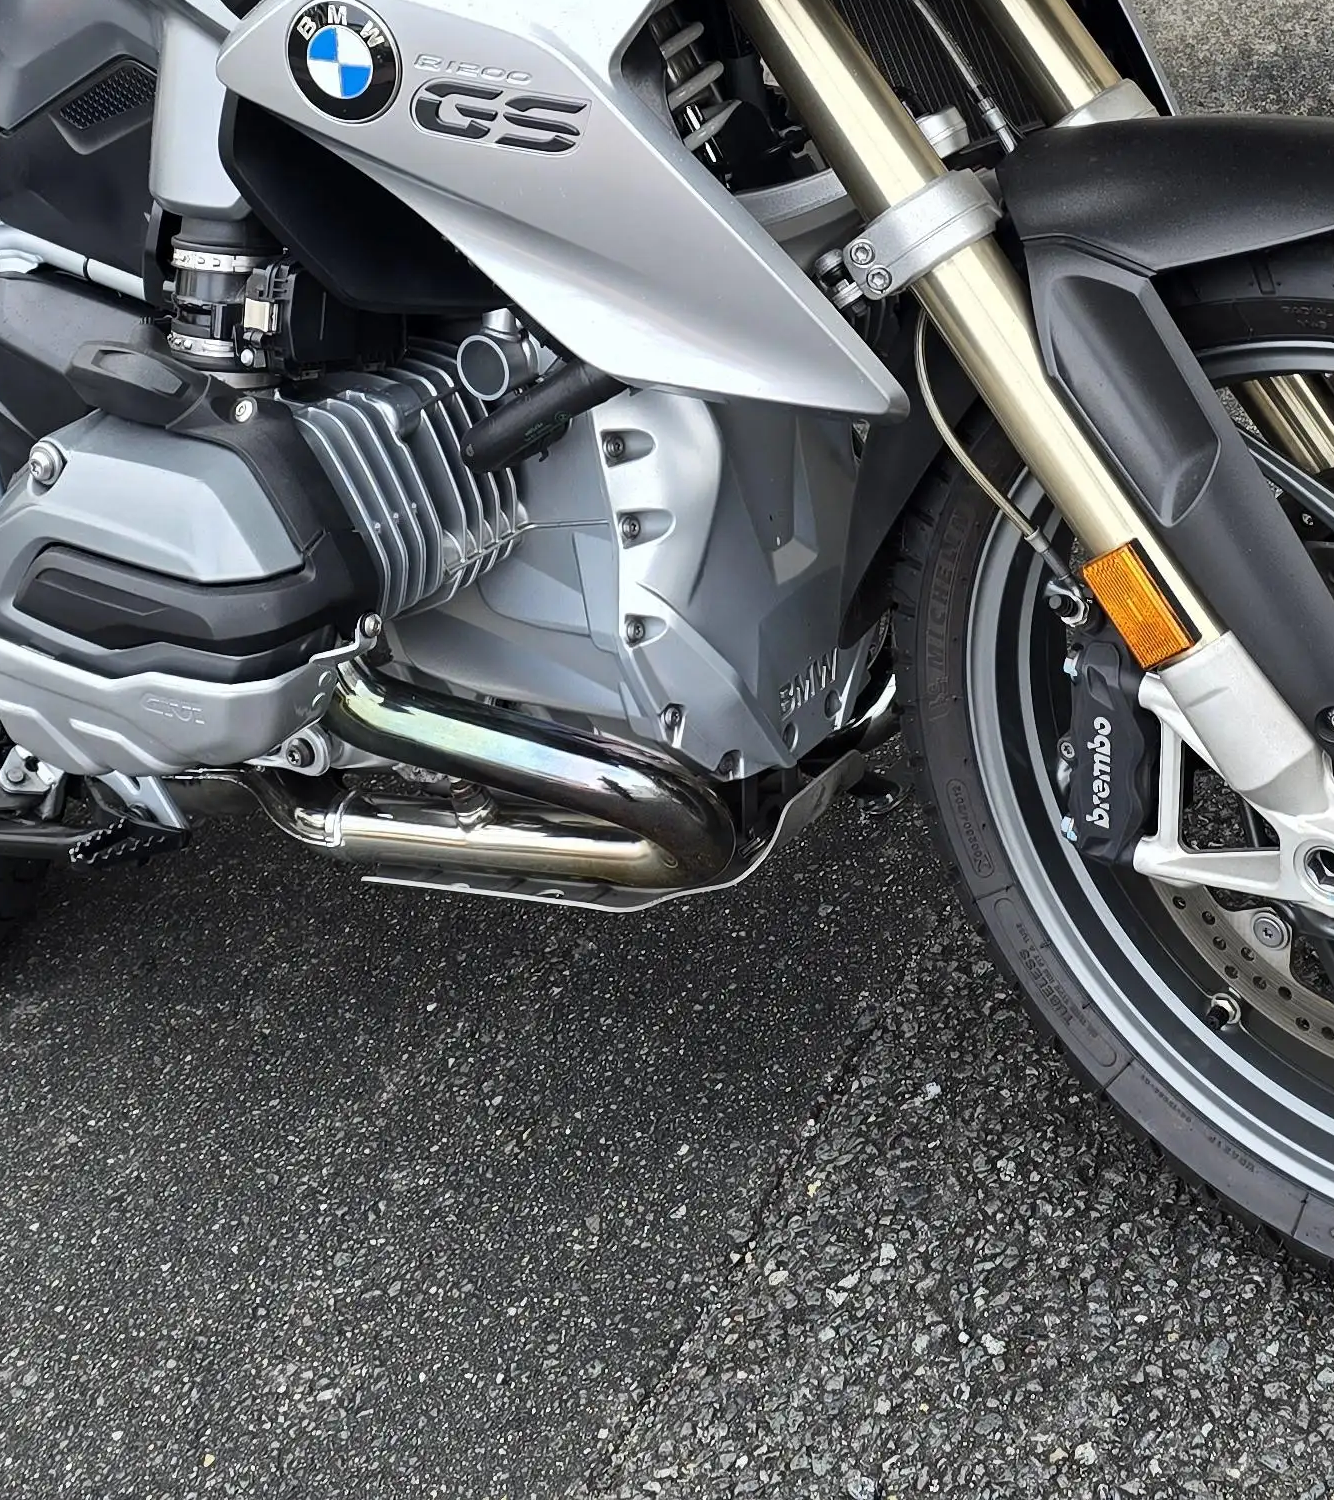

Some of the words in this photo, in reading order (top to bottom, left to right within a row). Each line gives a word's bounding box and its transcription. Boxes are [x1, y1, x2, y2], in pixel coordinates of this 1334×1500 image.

[296, 4, 386, 49] BMW
[414, 80, 589, 155] GS
[926, 507, 970, 672] MICHELIN
[779, 647, 838, 722] BMW
[1085, 716, 1112, 829] brembo
